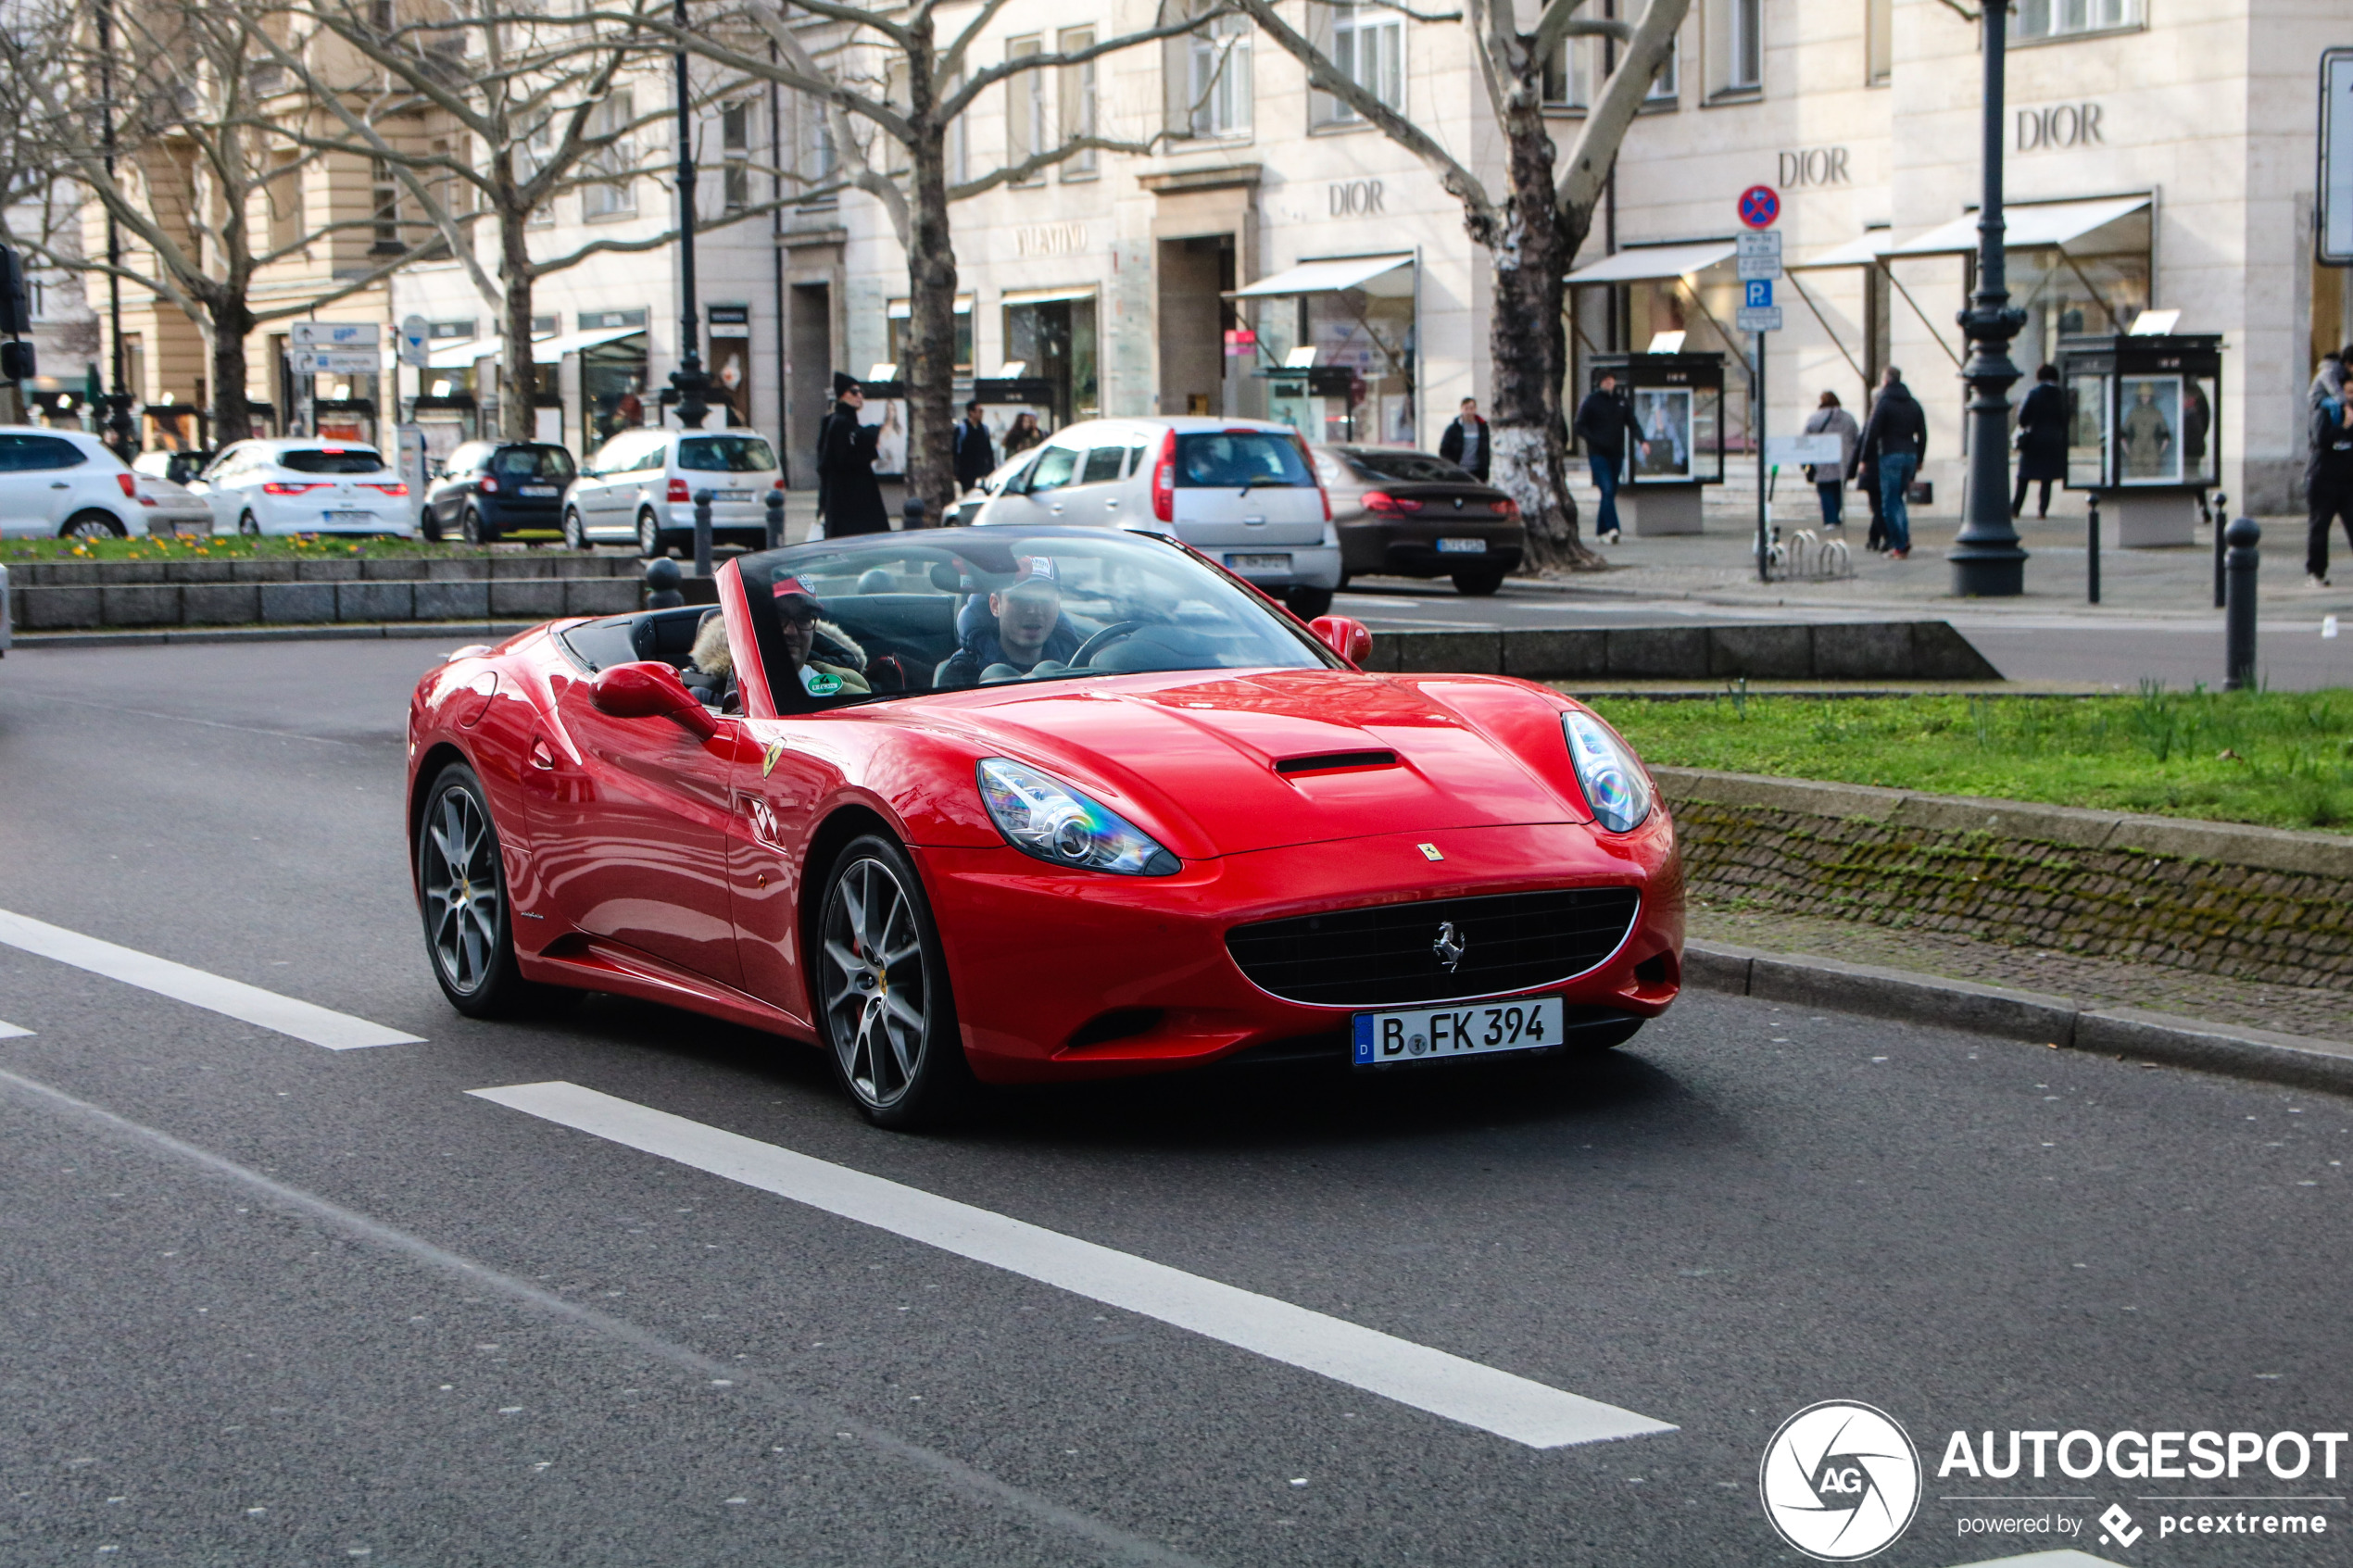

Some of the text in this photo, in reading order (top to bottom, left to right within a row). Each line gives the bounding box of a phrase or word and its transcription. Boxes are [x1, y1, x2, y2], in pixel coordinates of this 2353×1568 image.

[2017, 103, 2105, 151] DIOR
[1779, 147, 1851, 188] DIOR
[1329, 181, 1386, 217] DIOR
[1360, 1044, 1368, 1055] D
[1383, 1004, 1544, 1056] B FK 394
